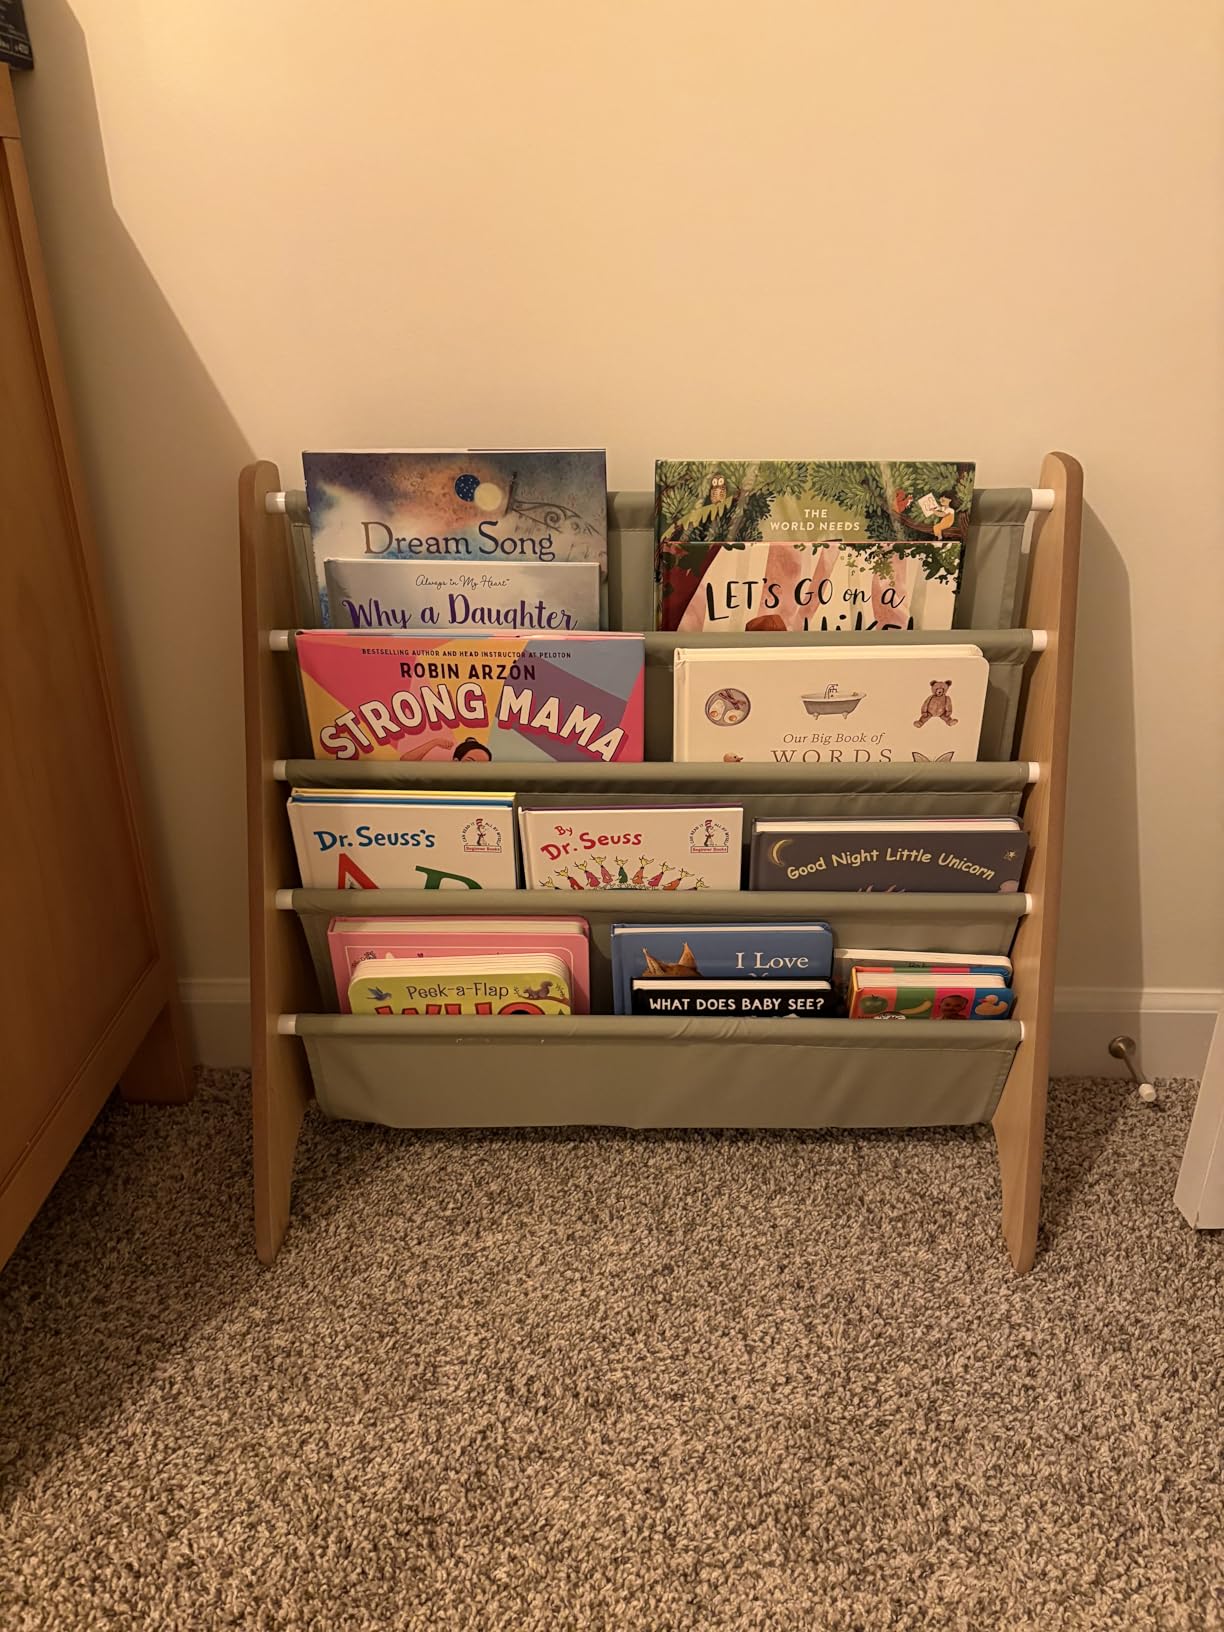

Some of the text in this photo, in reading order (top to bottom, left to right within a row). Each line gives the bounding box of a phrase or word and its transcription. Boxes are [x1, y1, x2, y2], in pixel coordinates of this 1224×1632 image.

[804, 508, 828, 518] THE
[770, 521, 860, 531] WORLD NEEDS
[361, 520, 556, 561] Dream Song
[416, 575, 447, 590] Always
[450, 578, 459, 586] in
[459, 575, 479, 590] My
[706, 577, 781, 622] LET'S
[794, 578, 833, 606] GO
[843, 585, 872, 605] on
[880, 586, 905, 608] a
[342, 593, 578, 630] Why a Daughter
[361, 648, 409, 656] BESTSELLING
[412, 649, 440, 657] AUTHOR
[459, 650, 479, 658] HEAD
[481, 651, 526, 659] INSTRUCTOR
[400, 659, 536, 680] ROBIN ARZÓN
[320, 682, 627, 762] STRONG MAMA
[783, 732, 886, 745] Our Big Book of
[770, 748, 892, 763] WORDS
[313, 826, 436, 852] Dr. Seuss's
[554, 825, 573, 836] By
[540, 832, 642, 861] Dr. Seuss
[787, 848, 995, 881] Good Night Little Unicorn
[735, 952, 809, 969] I Love
[406, 982, 509, 1000] Peek-a-Flap
[649, 998, 825, 1010] WHAT DOES BABY SEE?
